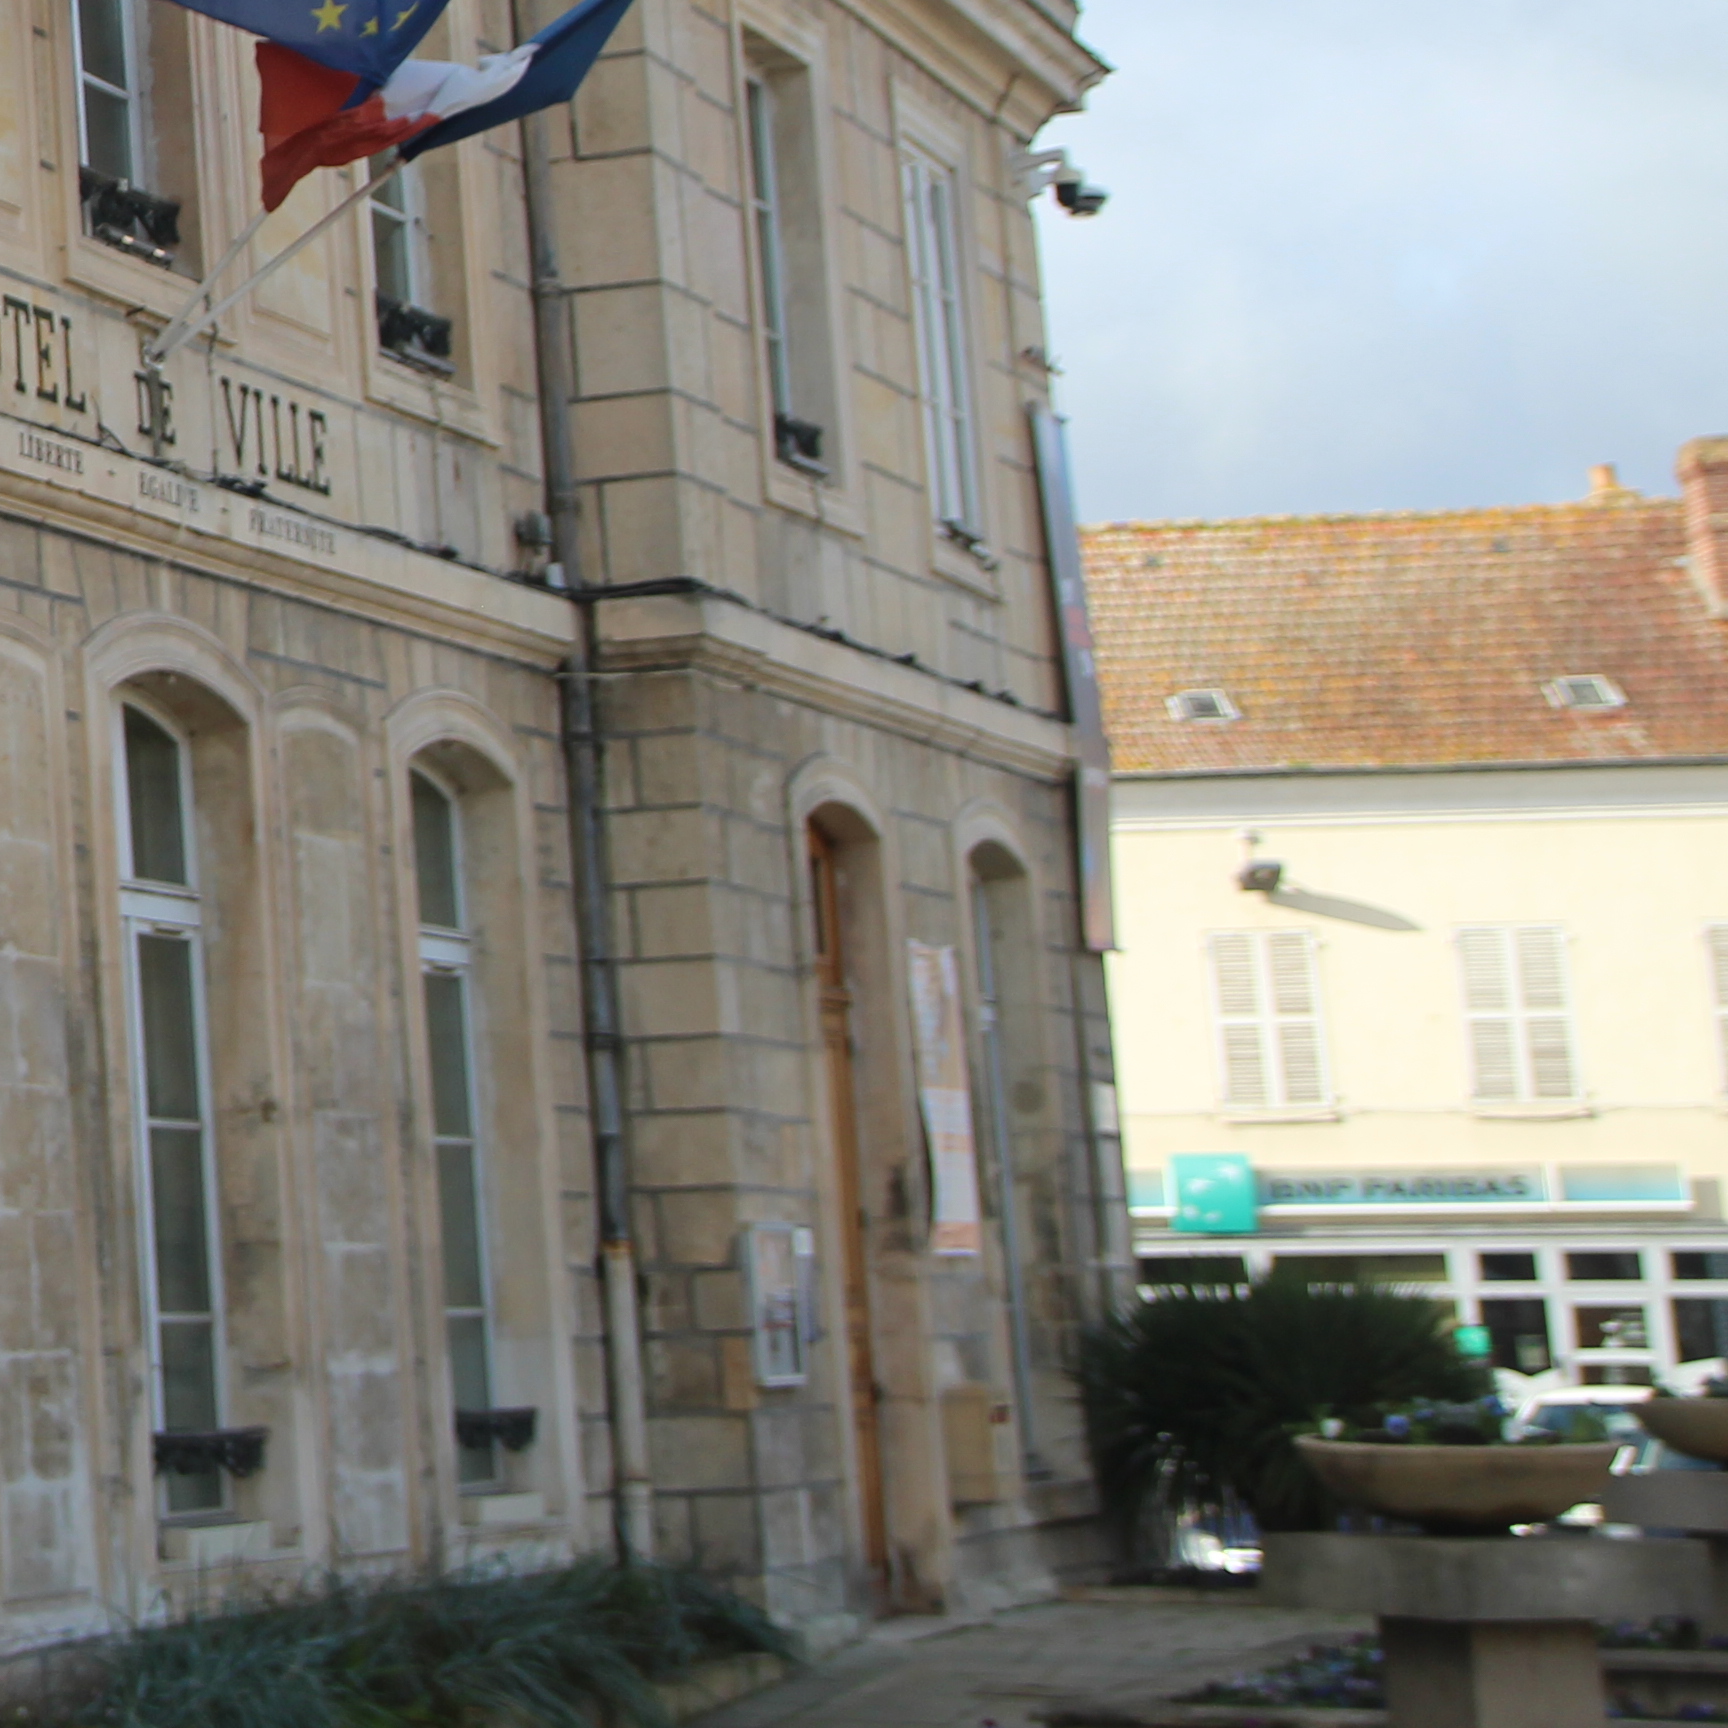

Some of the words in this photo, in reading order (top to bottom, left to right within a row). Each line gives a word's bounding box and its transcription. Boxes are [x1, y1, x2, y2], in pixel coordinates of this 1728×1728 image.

[221, 375, 331, 497] VILLE
[1269, 1174, 1350, 1199] BNP
[1360, 1173, 1529, 1198] PARIBAS
